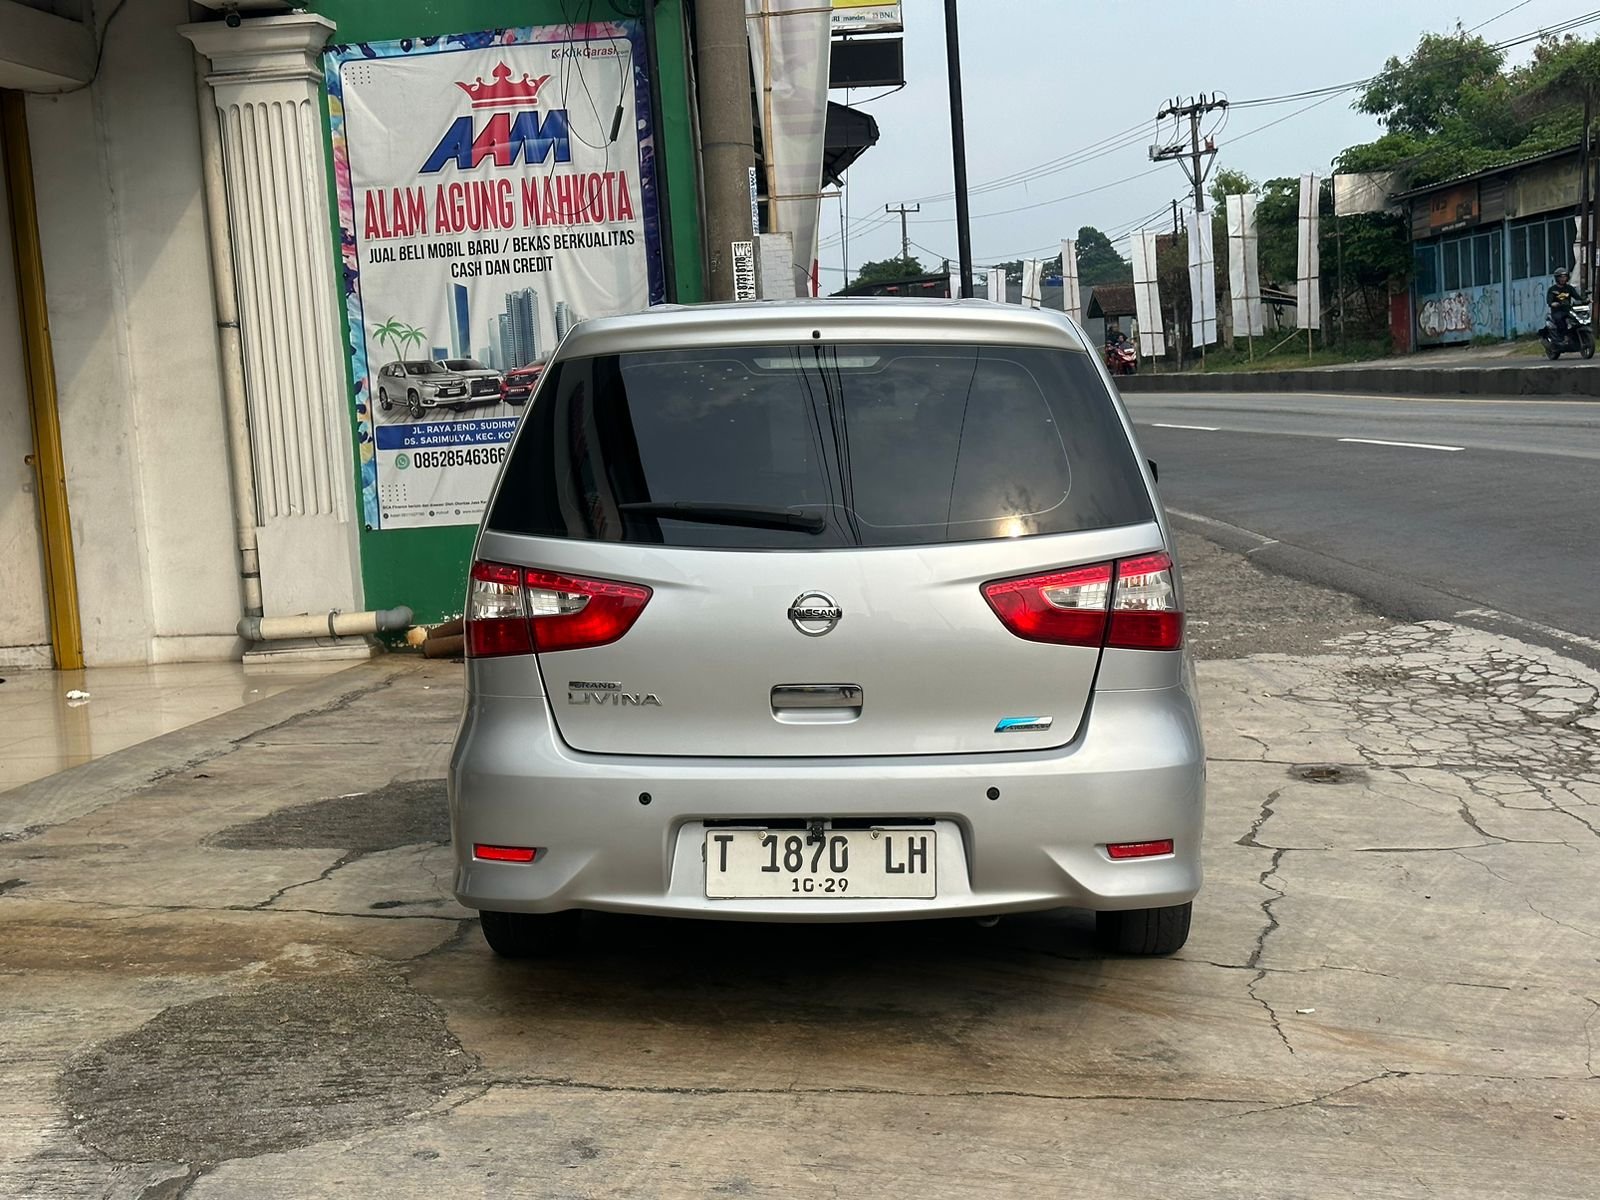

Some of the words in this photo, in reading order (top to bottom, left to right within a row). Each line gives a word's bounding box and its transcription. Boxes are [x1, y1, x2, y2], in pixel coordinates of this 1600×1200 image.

[418, 109, 572, 173] AAM
[364, 185, 427, 240] ALAM
[435, 177, 514, 236] AGUNG
[521, 169, 635, 228] MAHKOTA
[369, 247, 397, 264] JUAL
[399, 245, 425, 262] BELI
[428, 242, 466, 260] MOBIL
[467, 238, 499, 256] BARU
[513, 236, 551, 253] BEKAS
[554, 230, 635, 250] BERKUALITAS
[450, 261, 484, 278] CASH
[485, 259, 511, 276] DAN
[513, 256, 554, 274] CREDIT
[404, 437, 419, 445] DS.
[420, 434, 474, 444] SARIMULYA,
[475, 432, 496, 441] KEC.
[427, 425, 451, 433] RAYA
[452, 423, 479, 432] JEND.
[413, 447, 506, 469] 08528546366
[794, 609, 836, 617] NISSAN
[568, 692, 663, 706] LIVINA
[714, 835, 734, 872] T
[761, 835, 849, 873] 1870
[885, 836, 927, 874] LH
